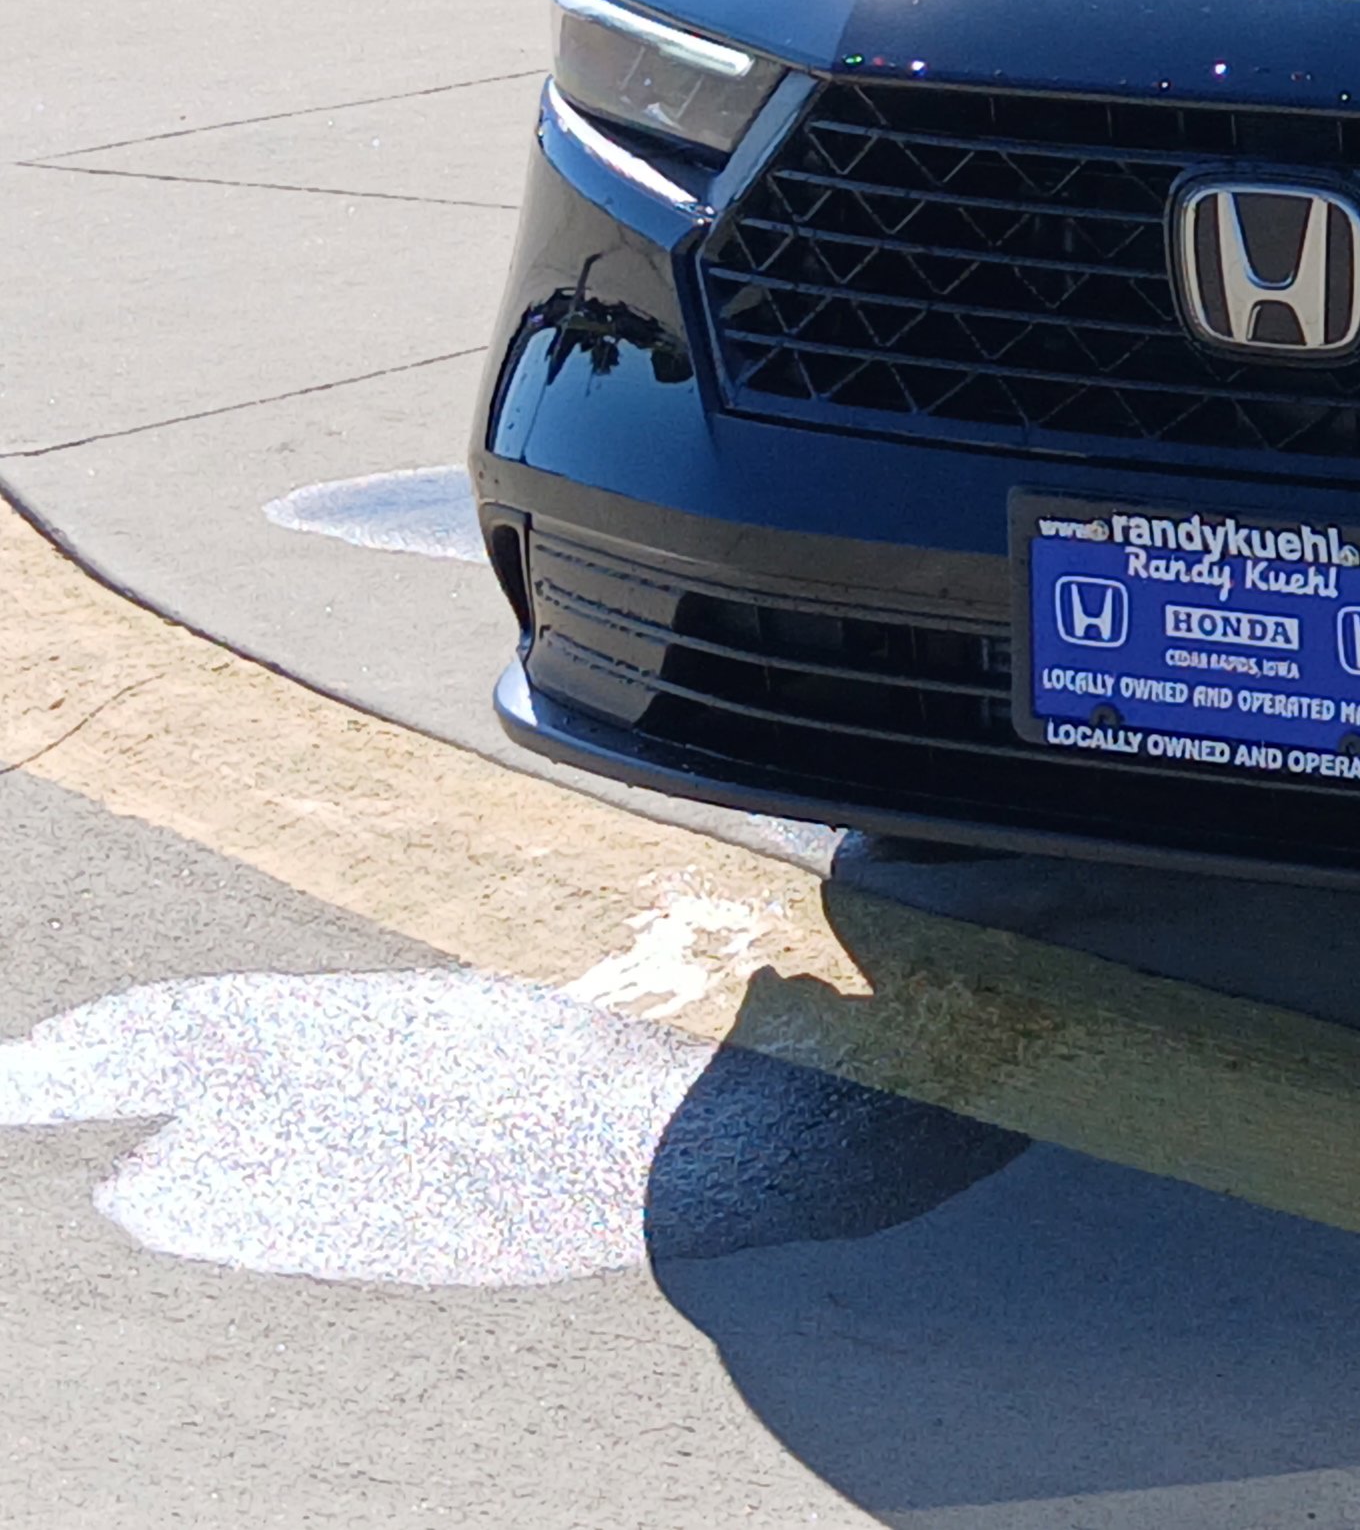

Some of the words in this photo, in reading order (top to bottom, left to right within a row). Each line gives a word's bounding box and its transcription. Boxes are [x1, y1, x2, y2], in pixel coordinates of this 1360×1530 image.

[1125, 546, 1230, 602] Randy
[1245, 559, 1339, 598] Kuehl
[1172, 609, 1293, 645] HONDA
[1043, 668, 1116, 698] LOCALLY
[1120, 676, 1188, 704] OWNED
[1193, 685, 1233, 710] AND
[1238, 689, 1335, 721] OPERATED
[1047, 719, 1143, 754] LOCALLY
[1147, 733, 1231, 764] OWNED
[1234, 743, 1283, 770] AND
